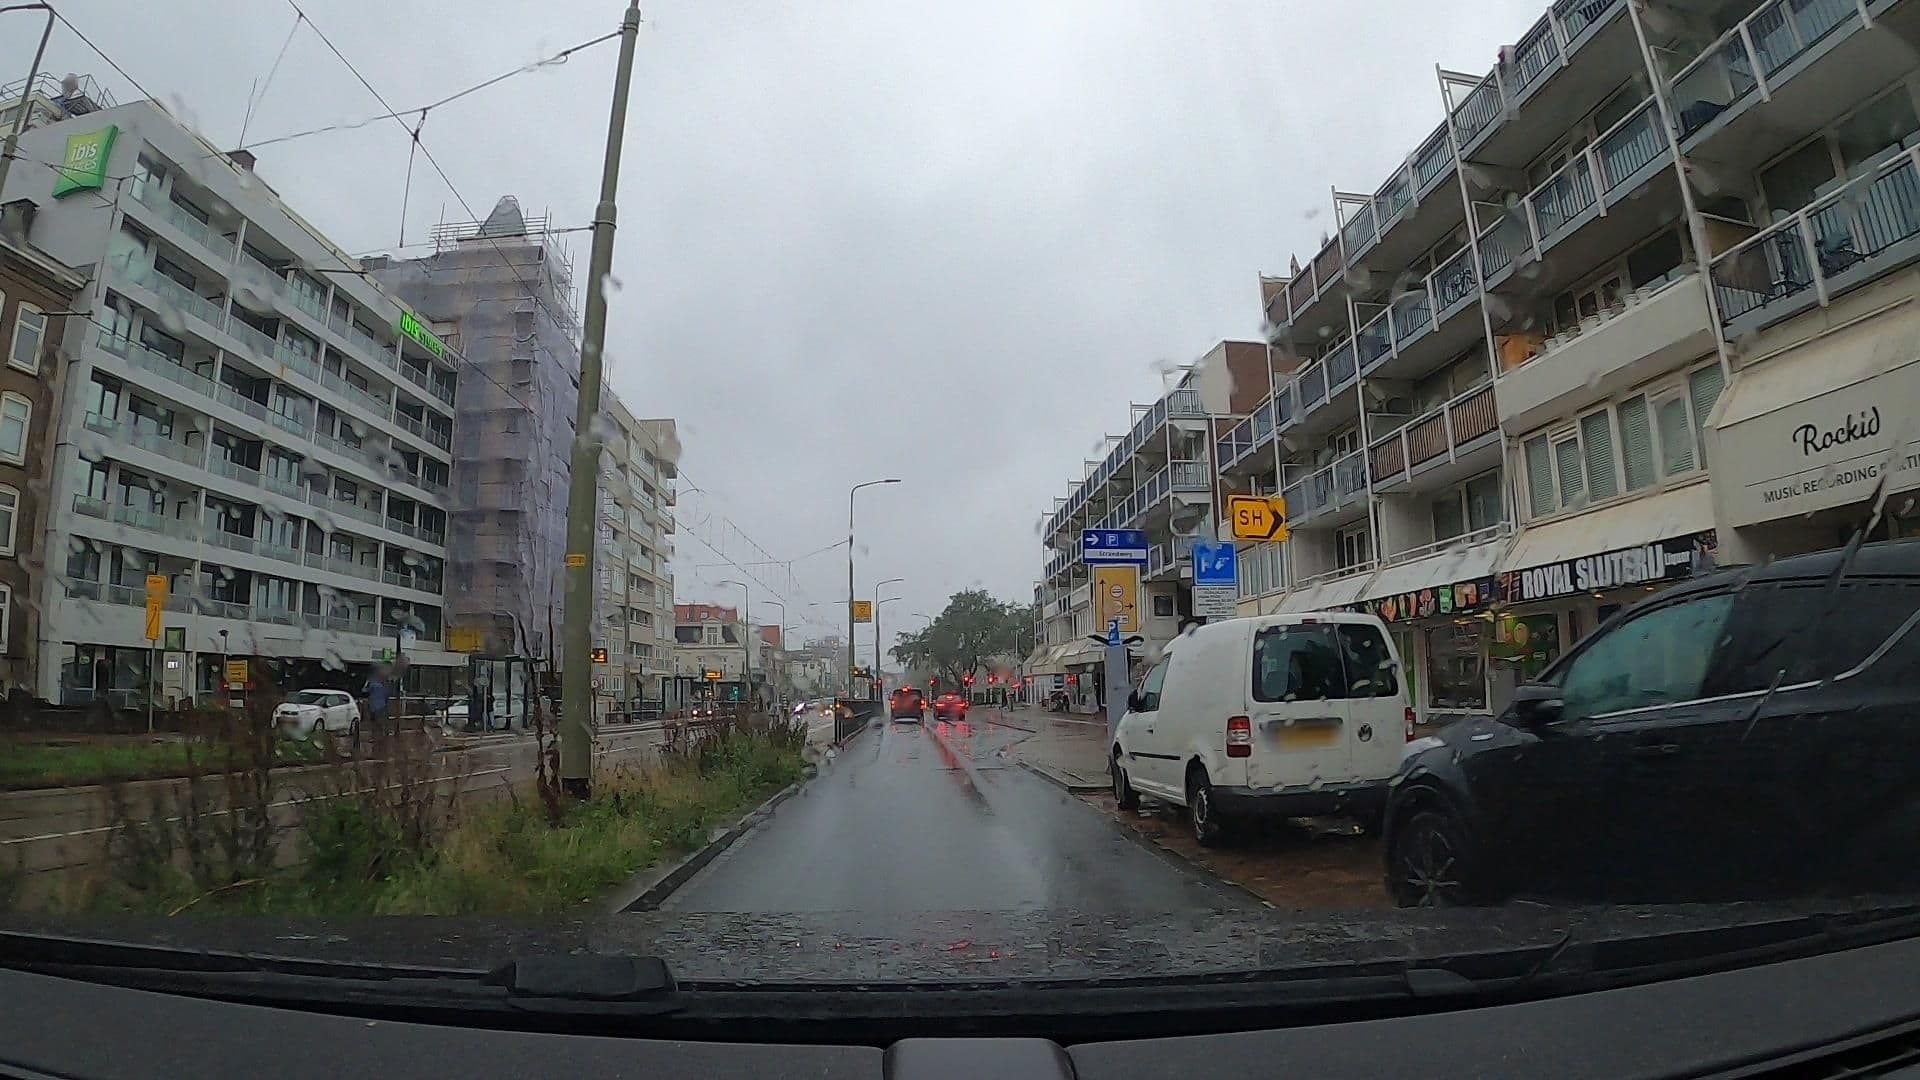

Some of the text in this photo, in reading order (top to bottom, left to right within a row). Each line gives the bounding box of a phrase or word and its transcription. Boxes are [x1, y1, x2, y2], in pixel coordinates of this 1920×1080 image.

[71, 140, 98, 162] ibis
[1792, 406, 1880, 456] Rockid
[1764, 465, 1878, 503] MUSIC RECORDING
[1239, 511, 1263, 526] SH
[1523, 564, 1574, 598] ROYAL
